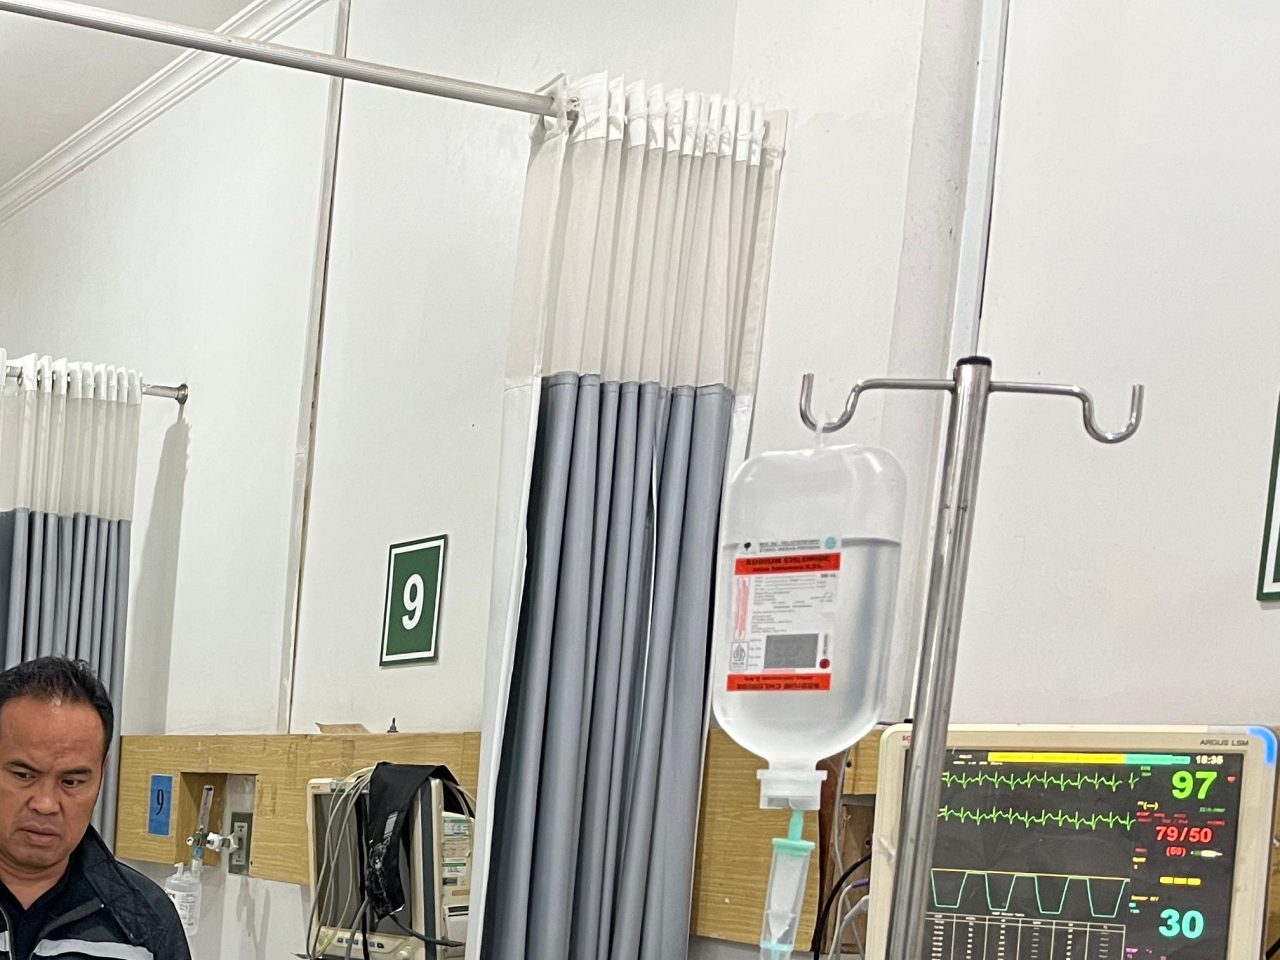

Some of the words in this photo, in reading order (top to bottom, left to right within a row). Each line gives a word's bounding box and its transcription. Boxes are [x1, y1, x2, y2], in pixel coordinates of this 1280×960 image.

[402, 573, 424, 630] 9
[1171, 770, 1218, 800] 97
[155, 788, 165, 816] 9
[1156, 826, 1213, 843] 79/50
[1158, 908, 1204, 939] 30
